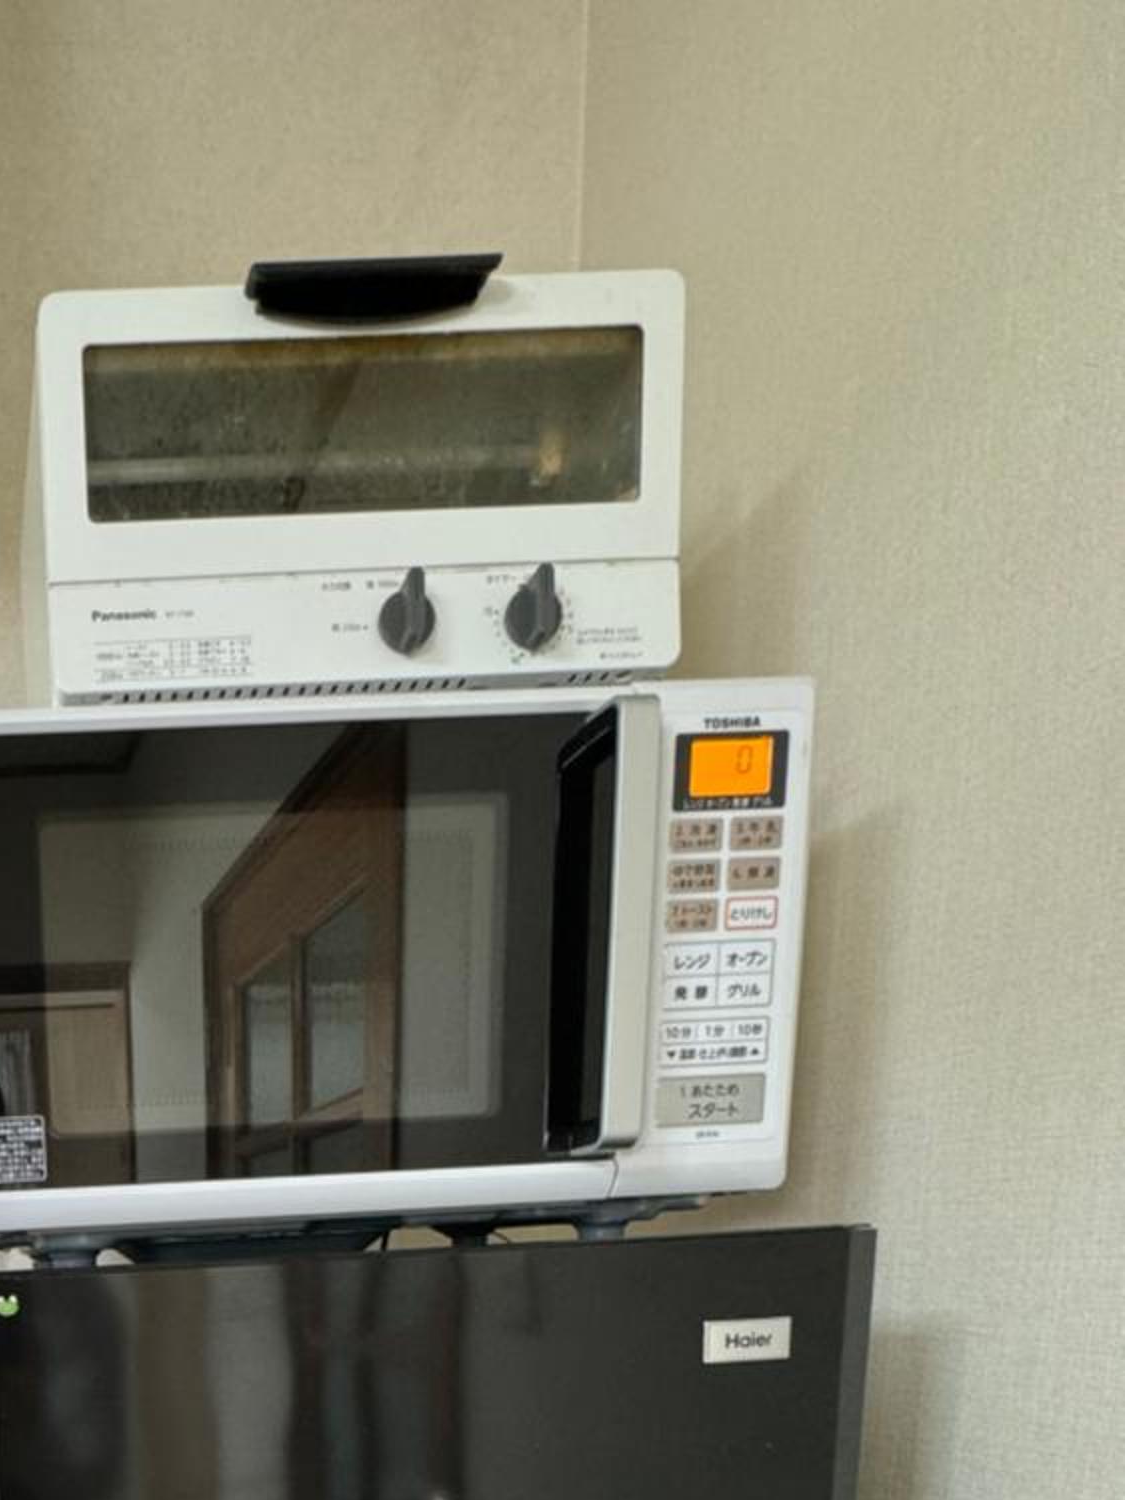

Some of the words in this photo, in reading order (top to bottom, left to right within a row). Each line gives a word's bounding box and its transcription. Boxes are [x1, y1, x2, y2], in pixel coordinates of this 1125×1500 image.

[91, 609, 157, 622] Panasonic
[703, 716, 761, 729] TOSHIBA
[730, 906, 772, 921] とりけし
[673, 953, 711, 970] レンジ
[727, 982, 762, 999] グリル
[690, 1082, 741, 1097] あたため
[687, 1102, 739, 1120] スタート
[724, 1331, 773, 1350] Haier
